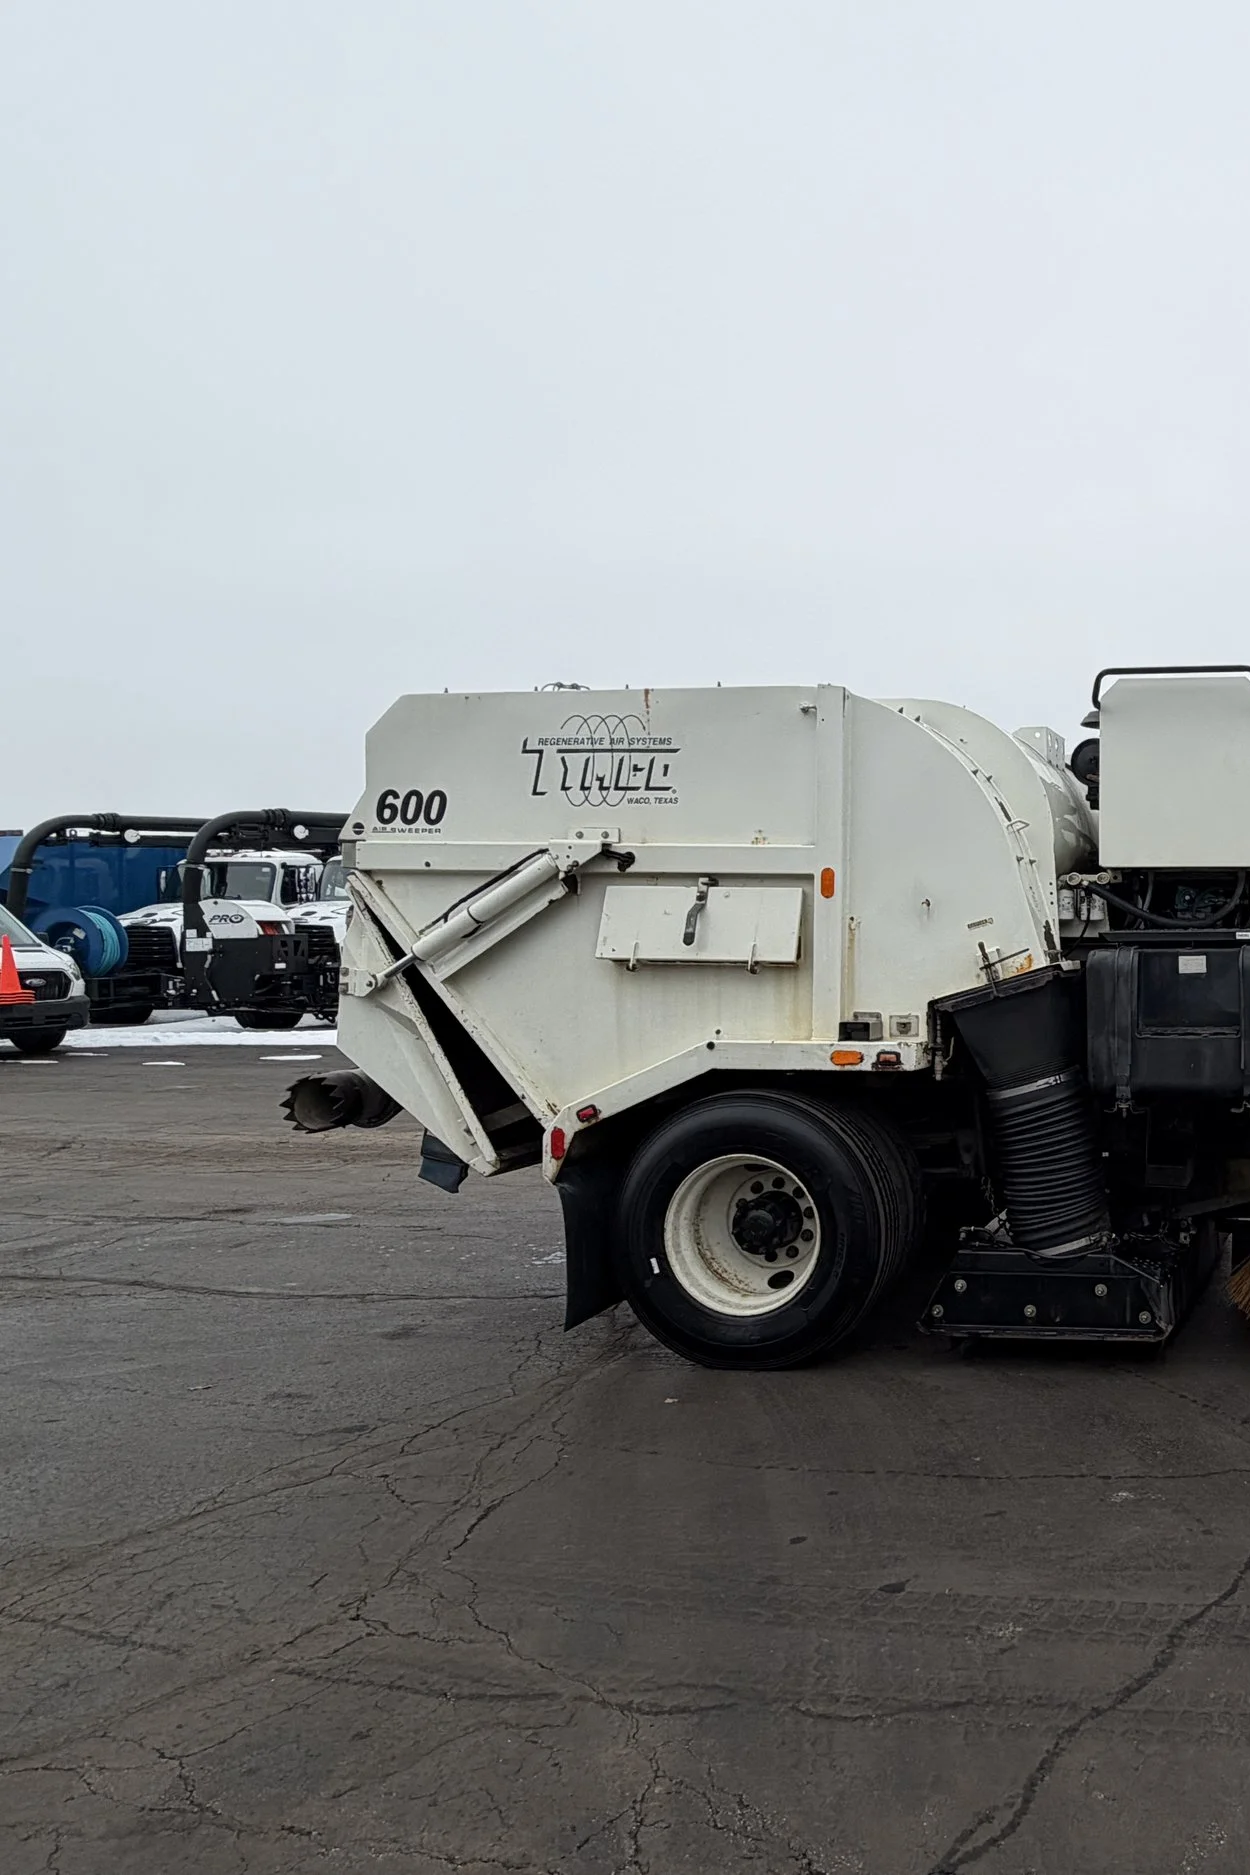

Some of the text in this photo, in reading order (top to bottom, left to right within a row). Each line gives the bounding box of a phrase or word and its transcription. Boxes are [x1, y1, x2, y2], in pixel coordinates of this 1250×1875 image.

[537, 737, 673, 746] REGENERATIVE AIR SYSTEMS
[626, 797, 679, 805] WACO, TEXAS
[376, 788, 448, 826] 600
[208, 914, 244, 924] PRO
